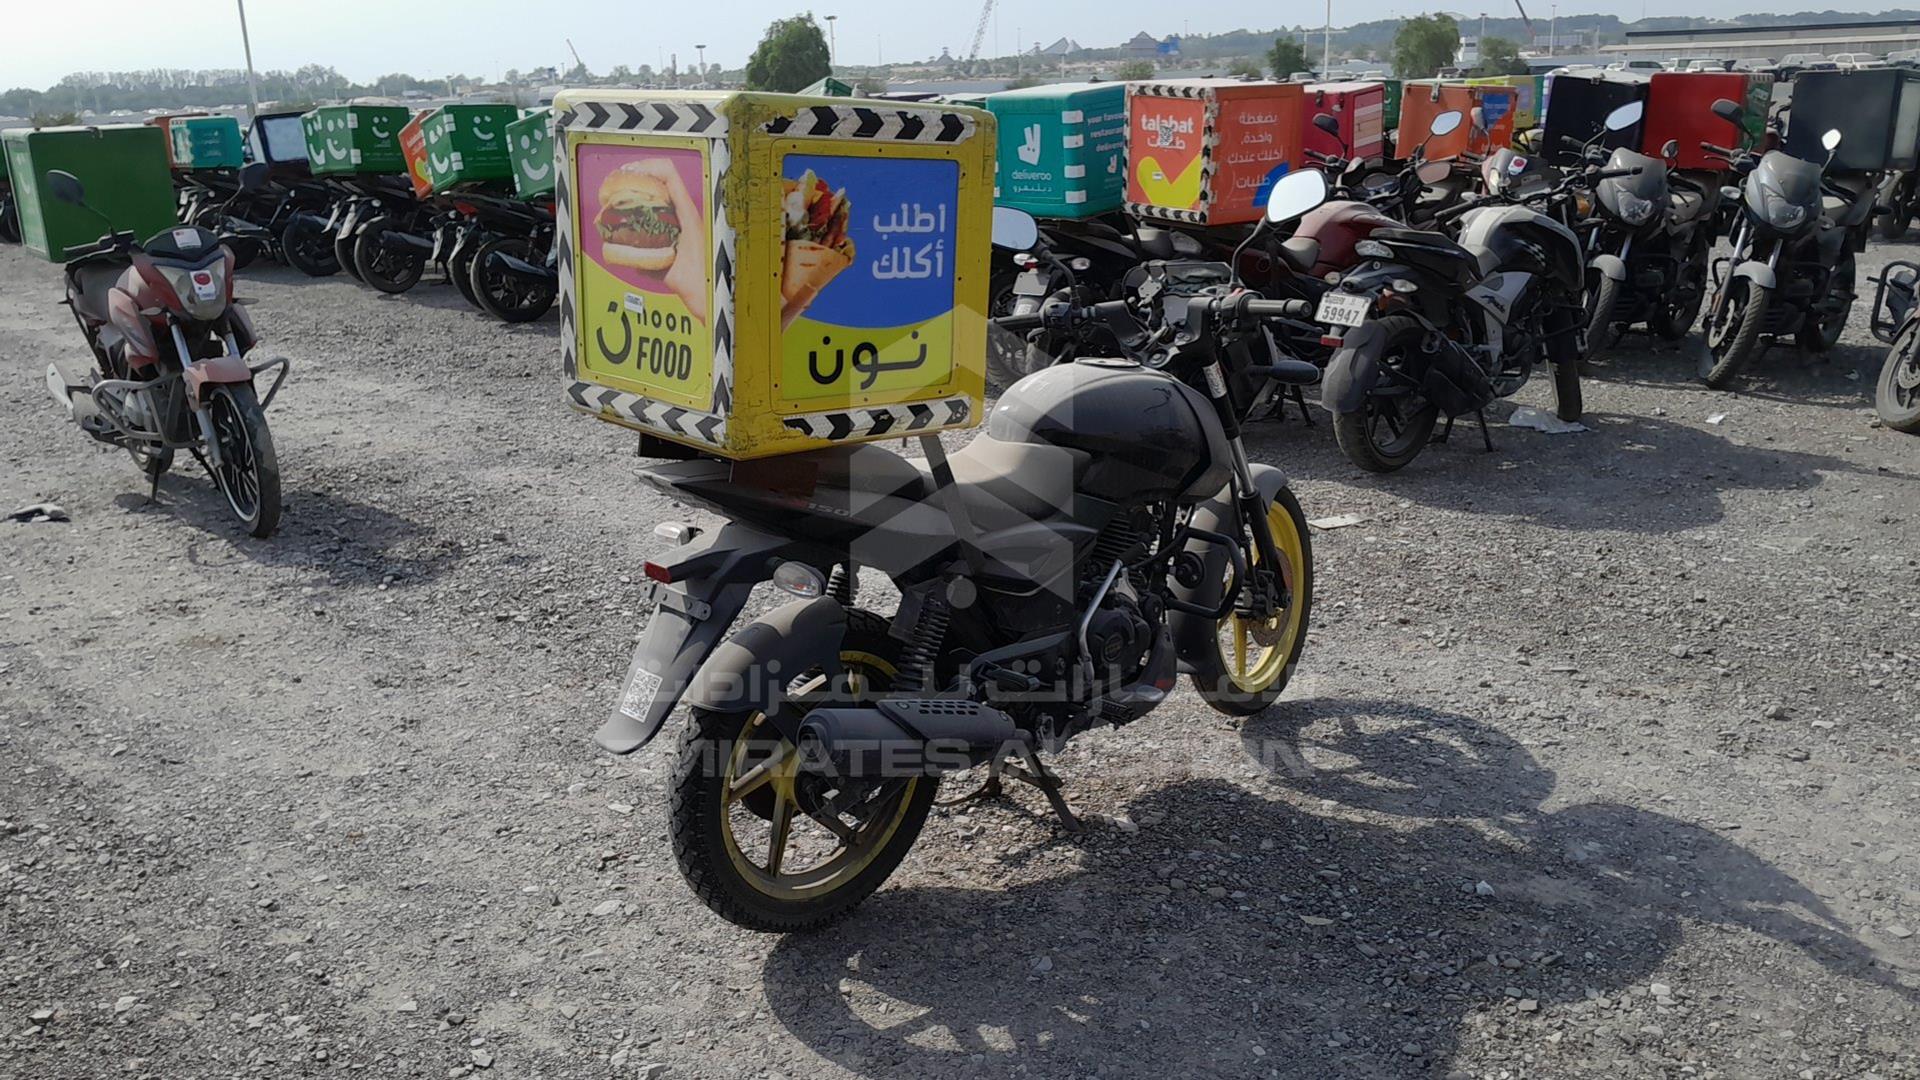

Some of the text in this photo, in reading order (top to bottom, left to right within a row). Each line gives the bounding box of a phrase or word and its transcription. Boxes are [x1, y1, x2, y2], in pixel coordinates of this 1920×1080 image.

[1141, 114, 1194, 134] talabat
[1011, 169, 1052, 180] deliveroo
[872, 239, 945, 280] أكلك
[637, 306, 692, 335] noon
[1321, 305, 1361, 324] 59947
[637, 336, 692, 380] FOOD
[809, 330, 927, 390] نون
